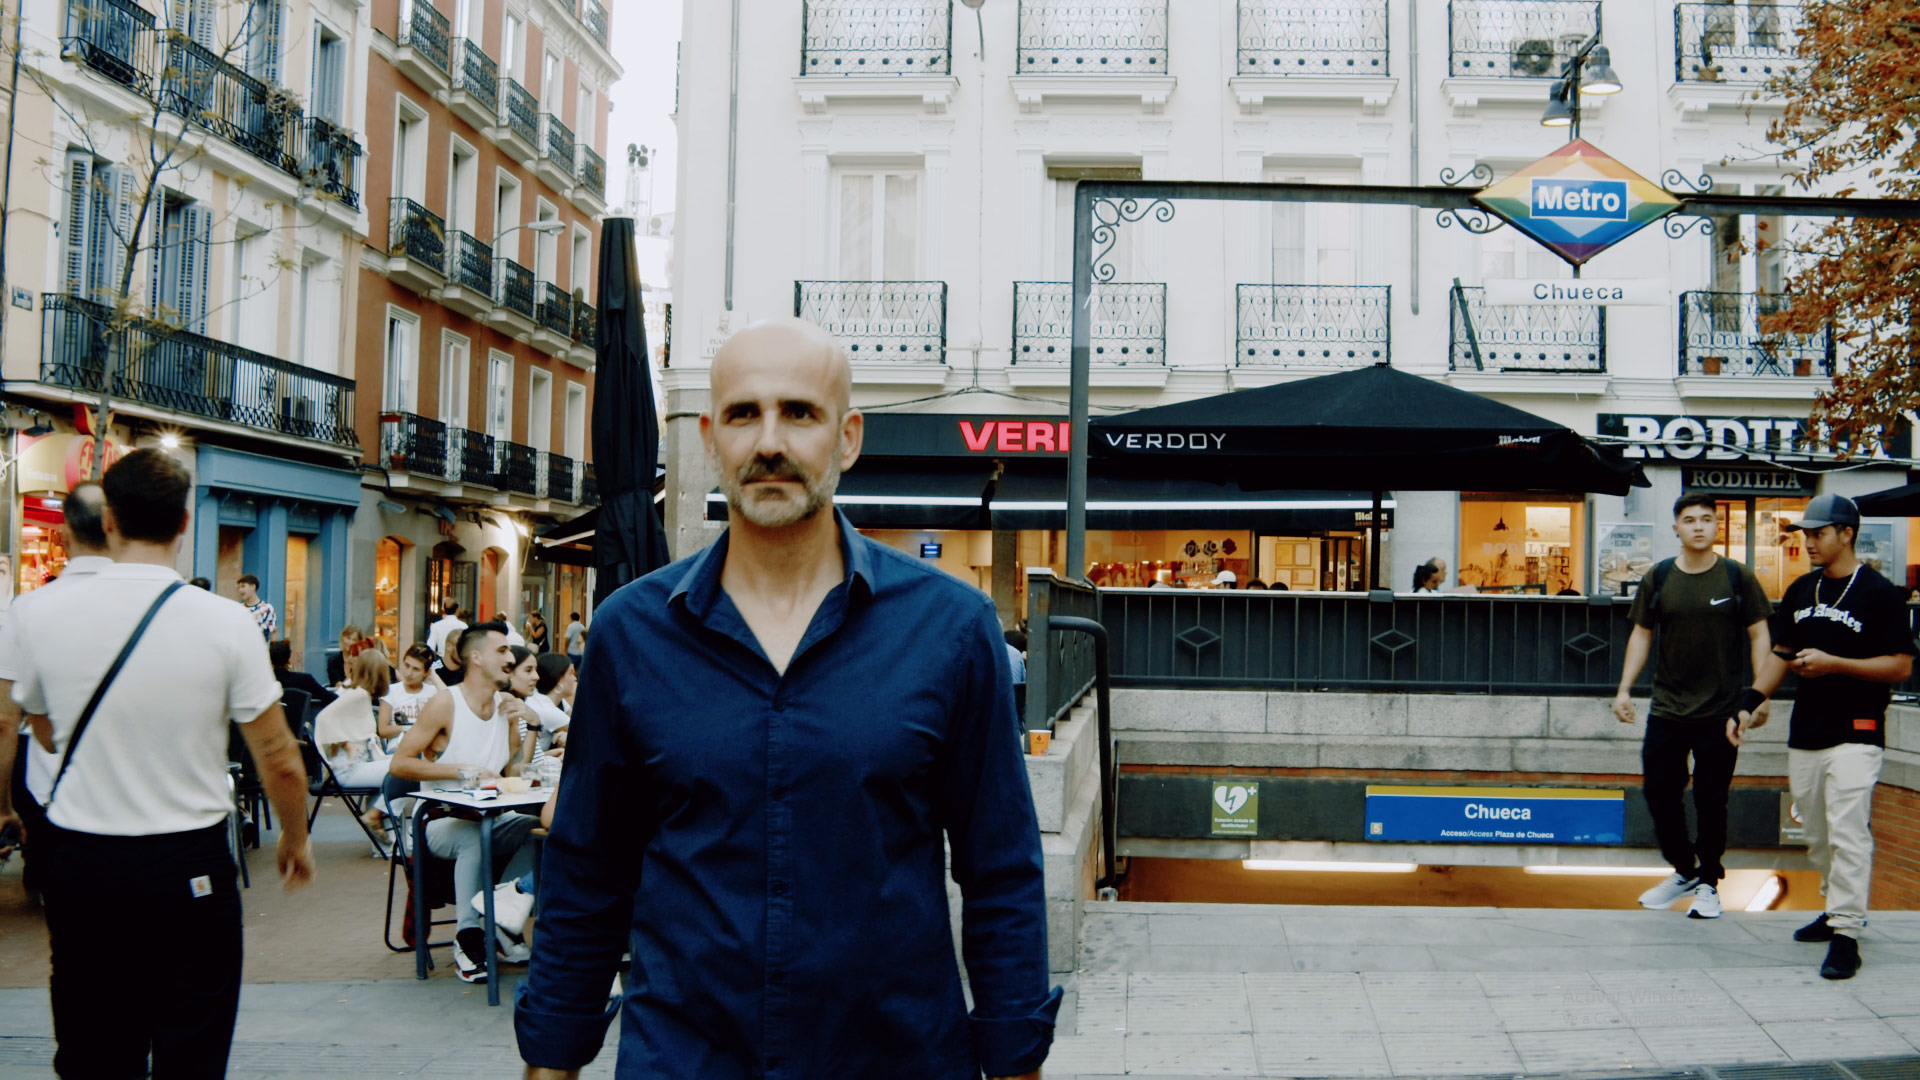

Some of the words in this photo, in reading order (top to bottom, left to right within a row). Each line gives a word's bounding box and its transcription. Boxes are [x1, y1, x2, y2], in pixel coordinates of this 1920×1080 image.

[1537, 185, 1621, 213] Metro
[1533, 282, 1625, 301] Chueca
[1105, 432, 1227, 450] VERDOY
[1690, 470, 1802, 490] RODILLA
[1354, 511, 1388, 521] Mau
[1812, 602, 1864, 633] Angeles
[1464, 803, 1532, 821] Chueca
[1440, 829, 1494, 838] Acceso/Access
[1495, 830, 1515, 839] Plaza
[1516, 831, 1526, 839] de
[1526, 831, 1554, 839] Chueca
